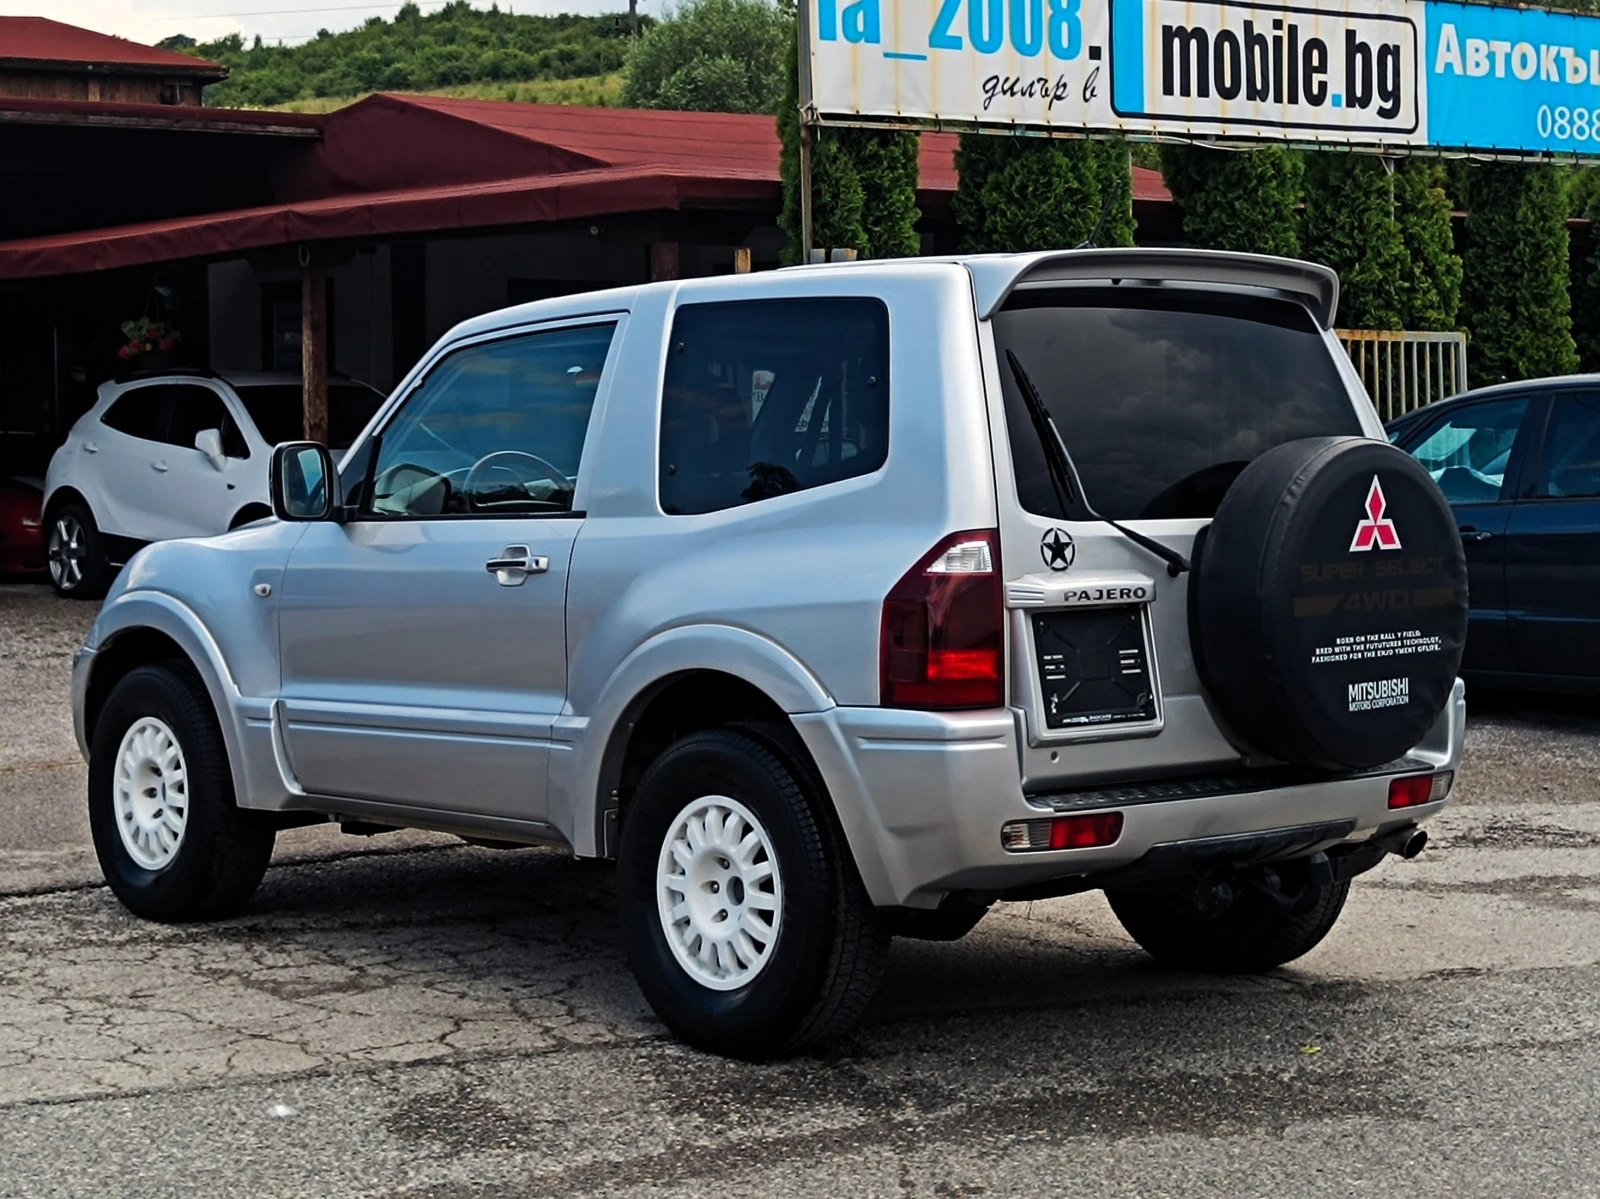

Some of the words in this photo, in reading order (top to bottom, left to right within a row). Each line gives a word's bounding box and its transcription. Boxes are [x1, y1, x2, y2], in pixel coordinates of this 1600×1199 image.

[1161, 19, 1401, 119] mobile.bg
[1300, 561, 1365, 583] SUPER
[1375, 555, 1449, 578] SELECT
[1063, 586, 1147, 602] PAJERO
[1342, 589, 1409, 612] 4WD
[1334, 644, 1351, 653] WITH
[1352, 643, 1364, 652] THE
[1336, 636, 1354, 645] BORN
[1349, 651, 1362, 660] FOR
[1363, 650, 1376, 658] THE
[1348, 677, 1409, 703] MITSUBISHI
[1349, 700, 1371, 712] MOTORS
[1372, 695, 1409, 709] CORPORATION
